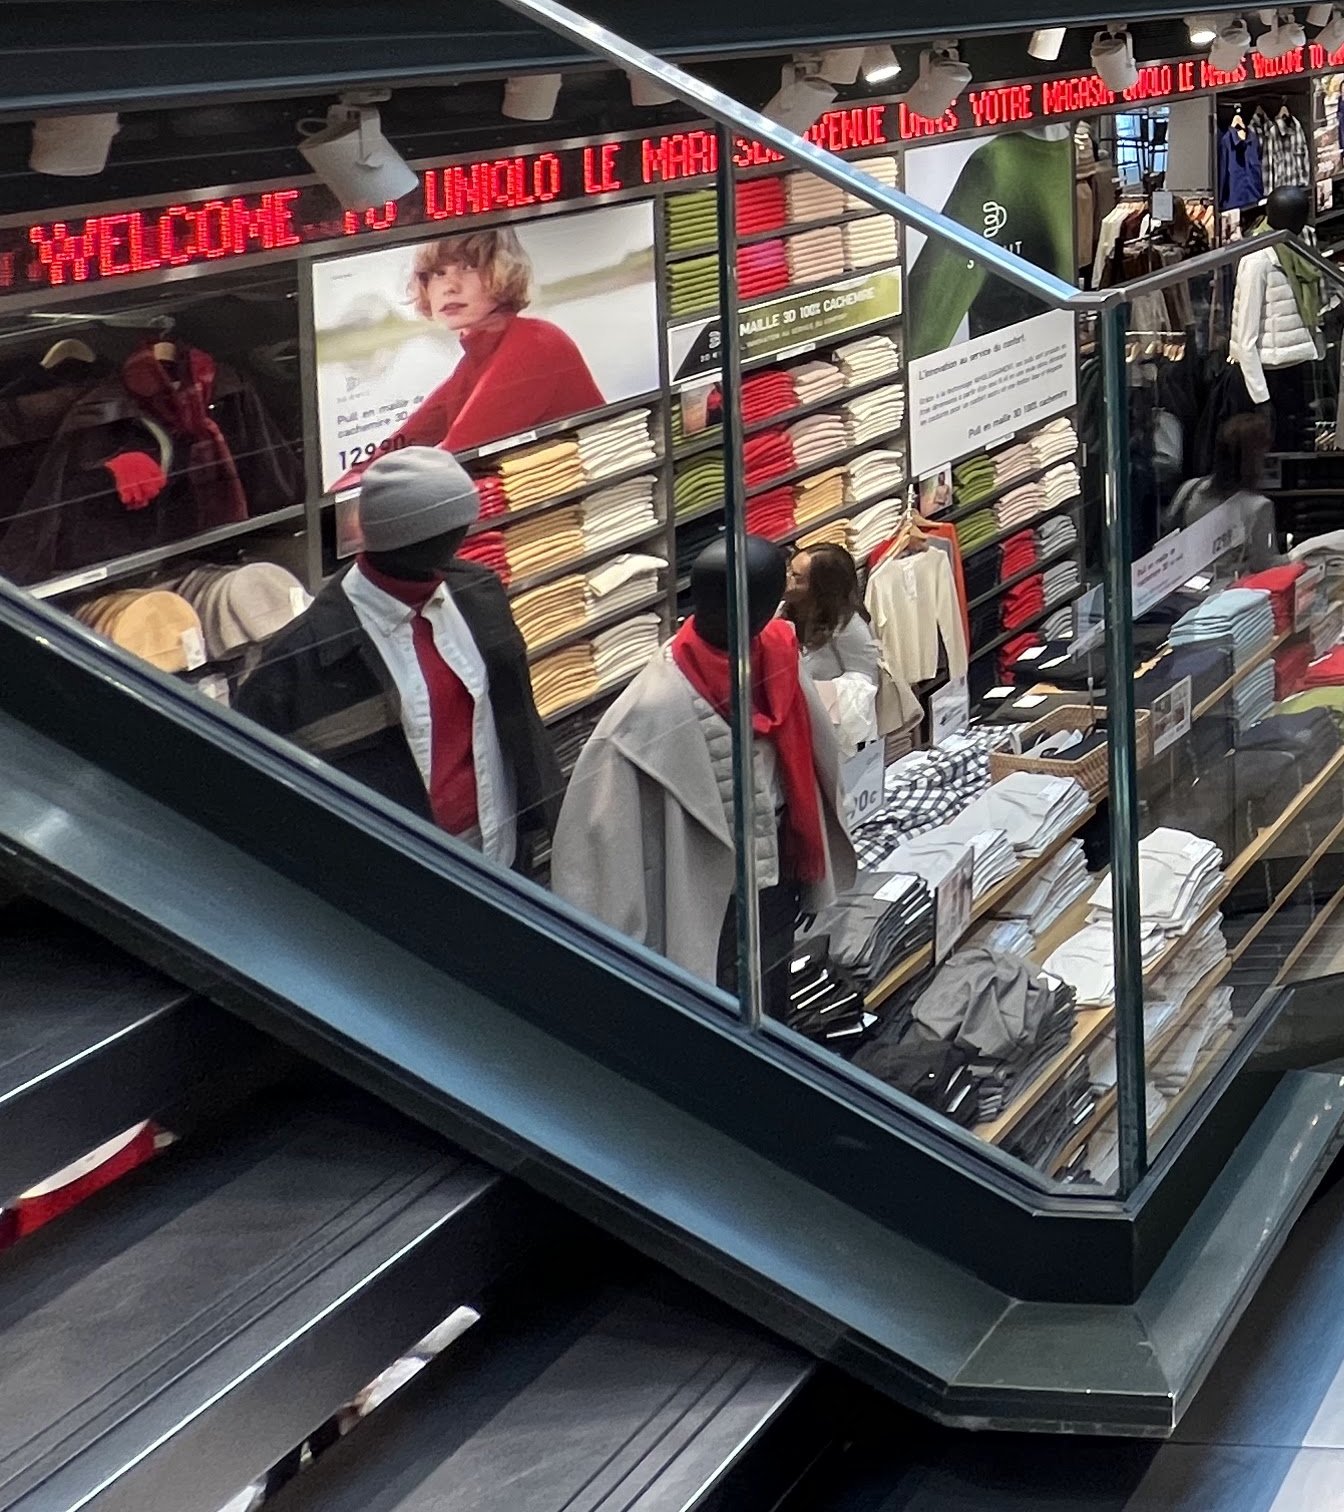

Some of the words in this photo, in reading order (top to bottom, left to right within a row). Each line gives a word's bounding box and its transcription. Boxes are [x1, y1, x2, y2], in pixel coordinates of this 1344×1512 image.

[29, 188, 300, 286] WELCOME
[423, 152, 558, 220] UNIQLO
[584, 143, 622, 195] LE
[968, 83, 1034, 137] VOTRE
[1178, 61, 1195, 92] LE
[739, 313, 780, 337] MAILLE
[783, 309, 796, 323] 3D
[799, 303, 822, 319] 100%
[337, 410, 358, 426] Pull
[362, 408, 375, 419] en
